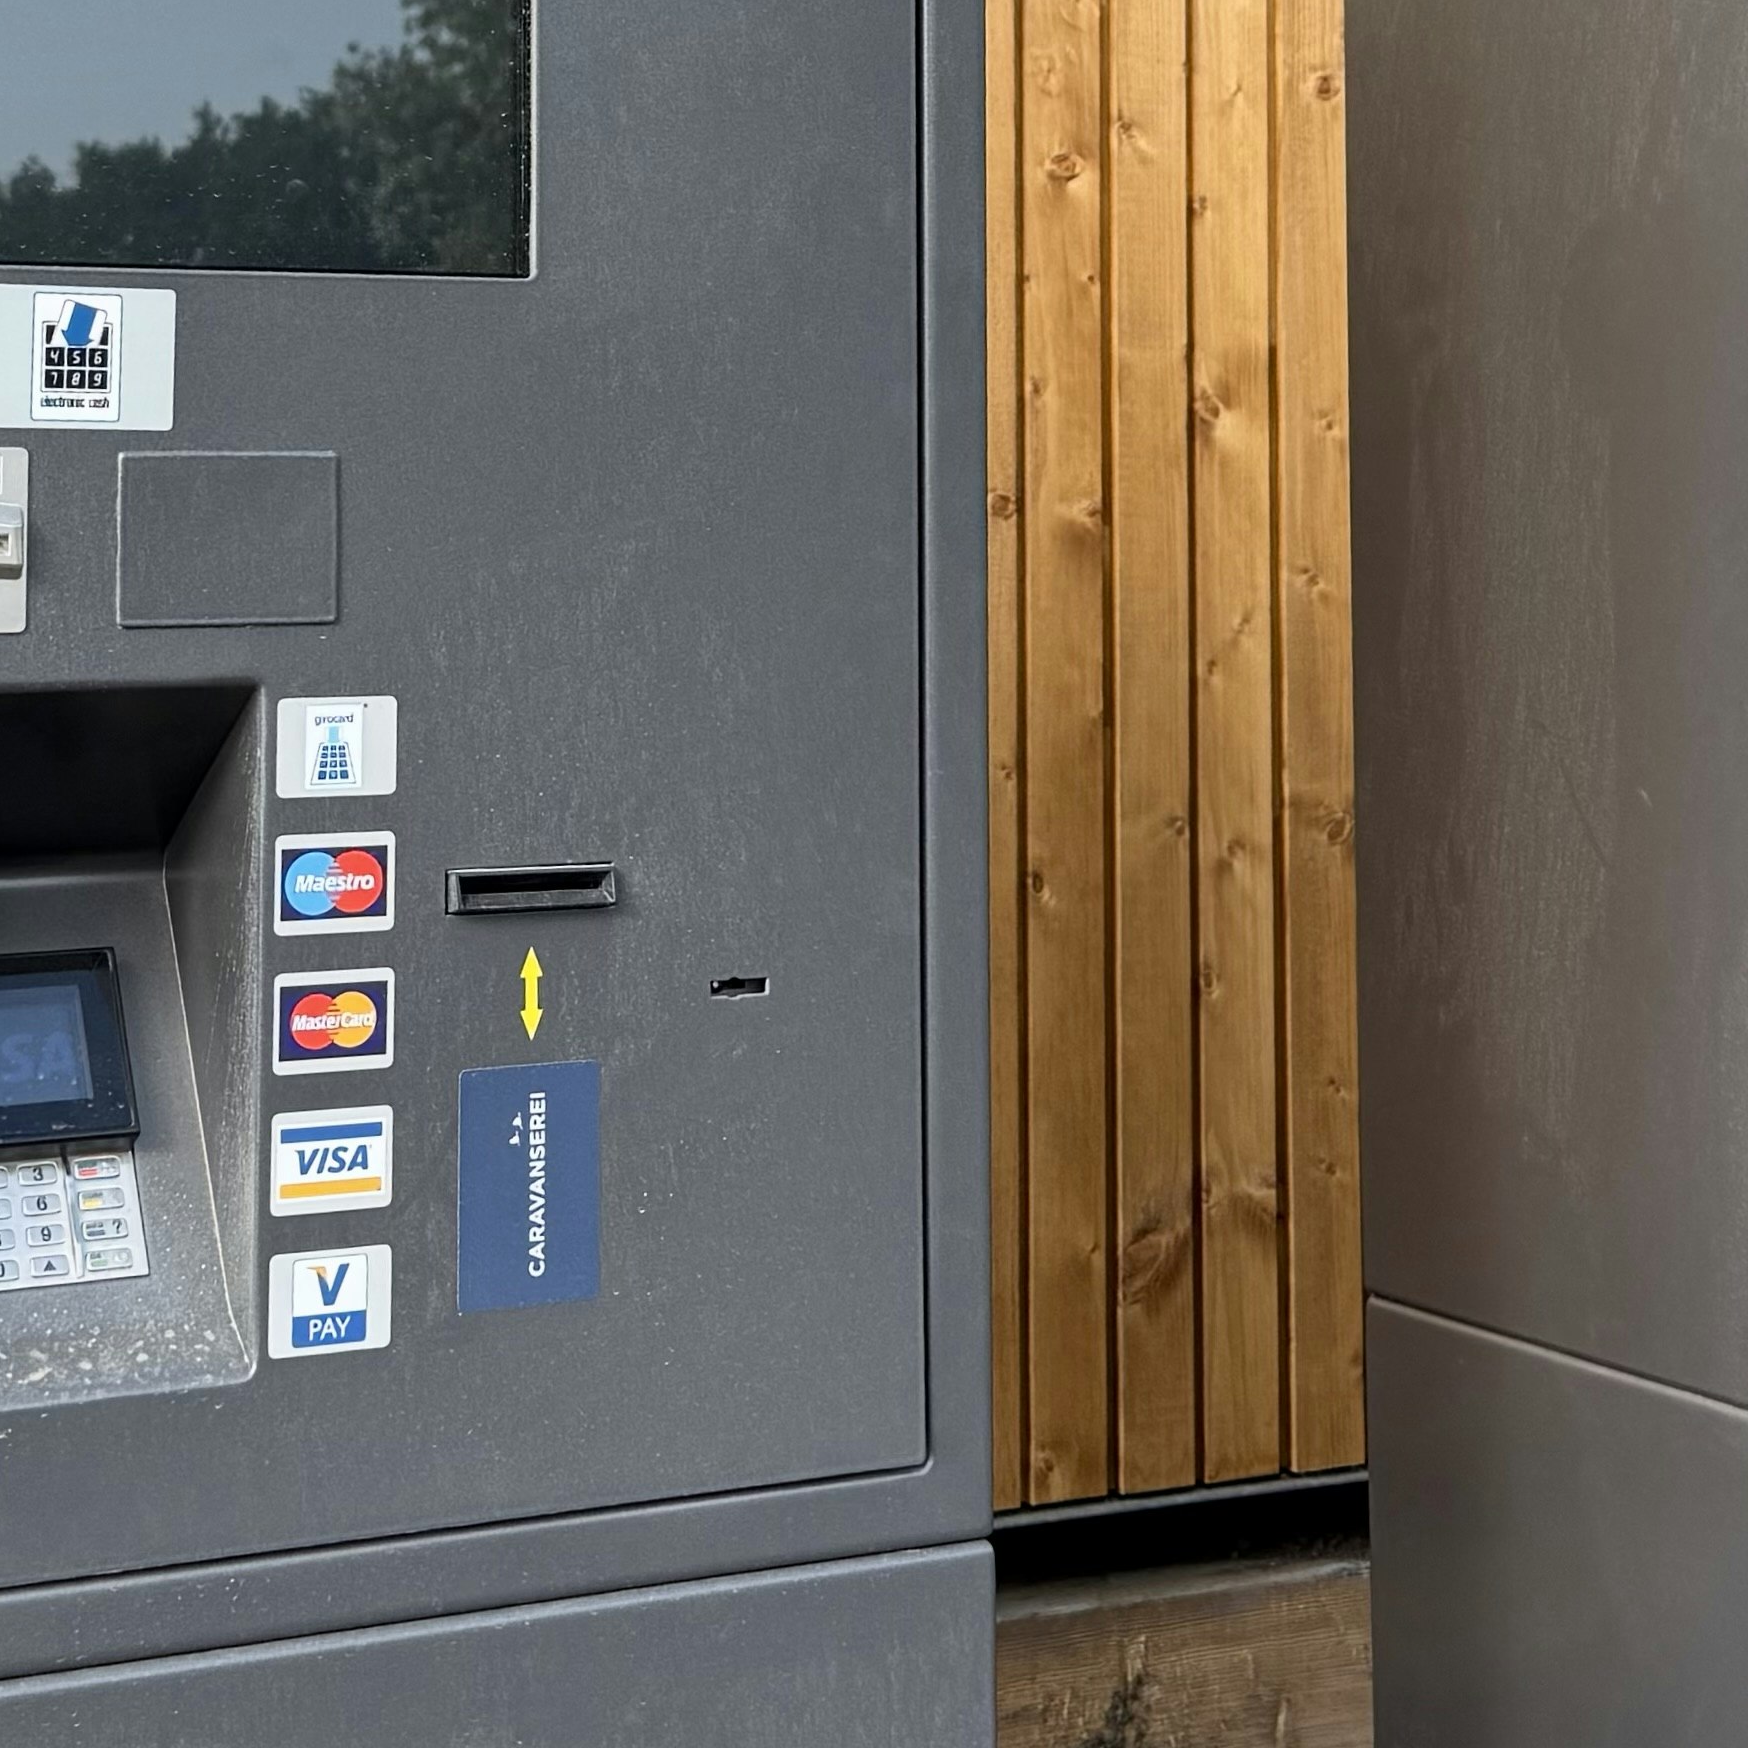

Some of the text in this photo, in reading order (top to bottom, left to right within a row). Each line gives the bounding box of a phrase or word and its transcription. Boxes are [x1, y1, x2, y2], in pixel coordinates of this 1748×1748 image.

[50, 350, 103, 364] 4 5 6
[50, 372, 102, 386] 7 8 9
[294, 872, 375, 893] Maestro
[291, 1009, 378, 1032] MasterCard
[295, 1144, 370, 1176] VISA
[33, 1167, 43, 1181] 3
[528, 1092, 546, 1278] CARAVANSEREI
[37, 1196, 47, 1211] 6
[41, 1226, 51, 1242] 9
[306, 1262, 350, 1306] V
[308, 1315, 352, 1341] PAY
